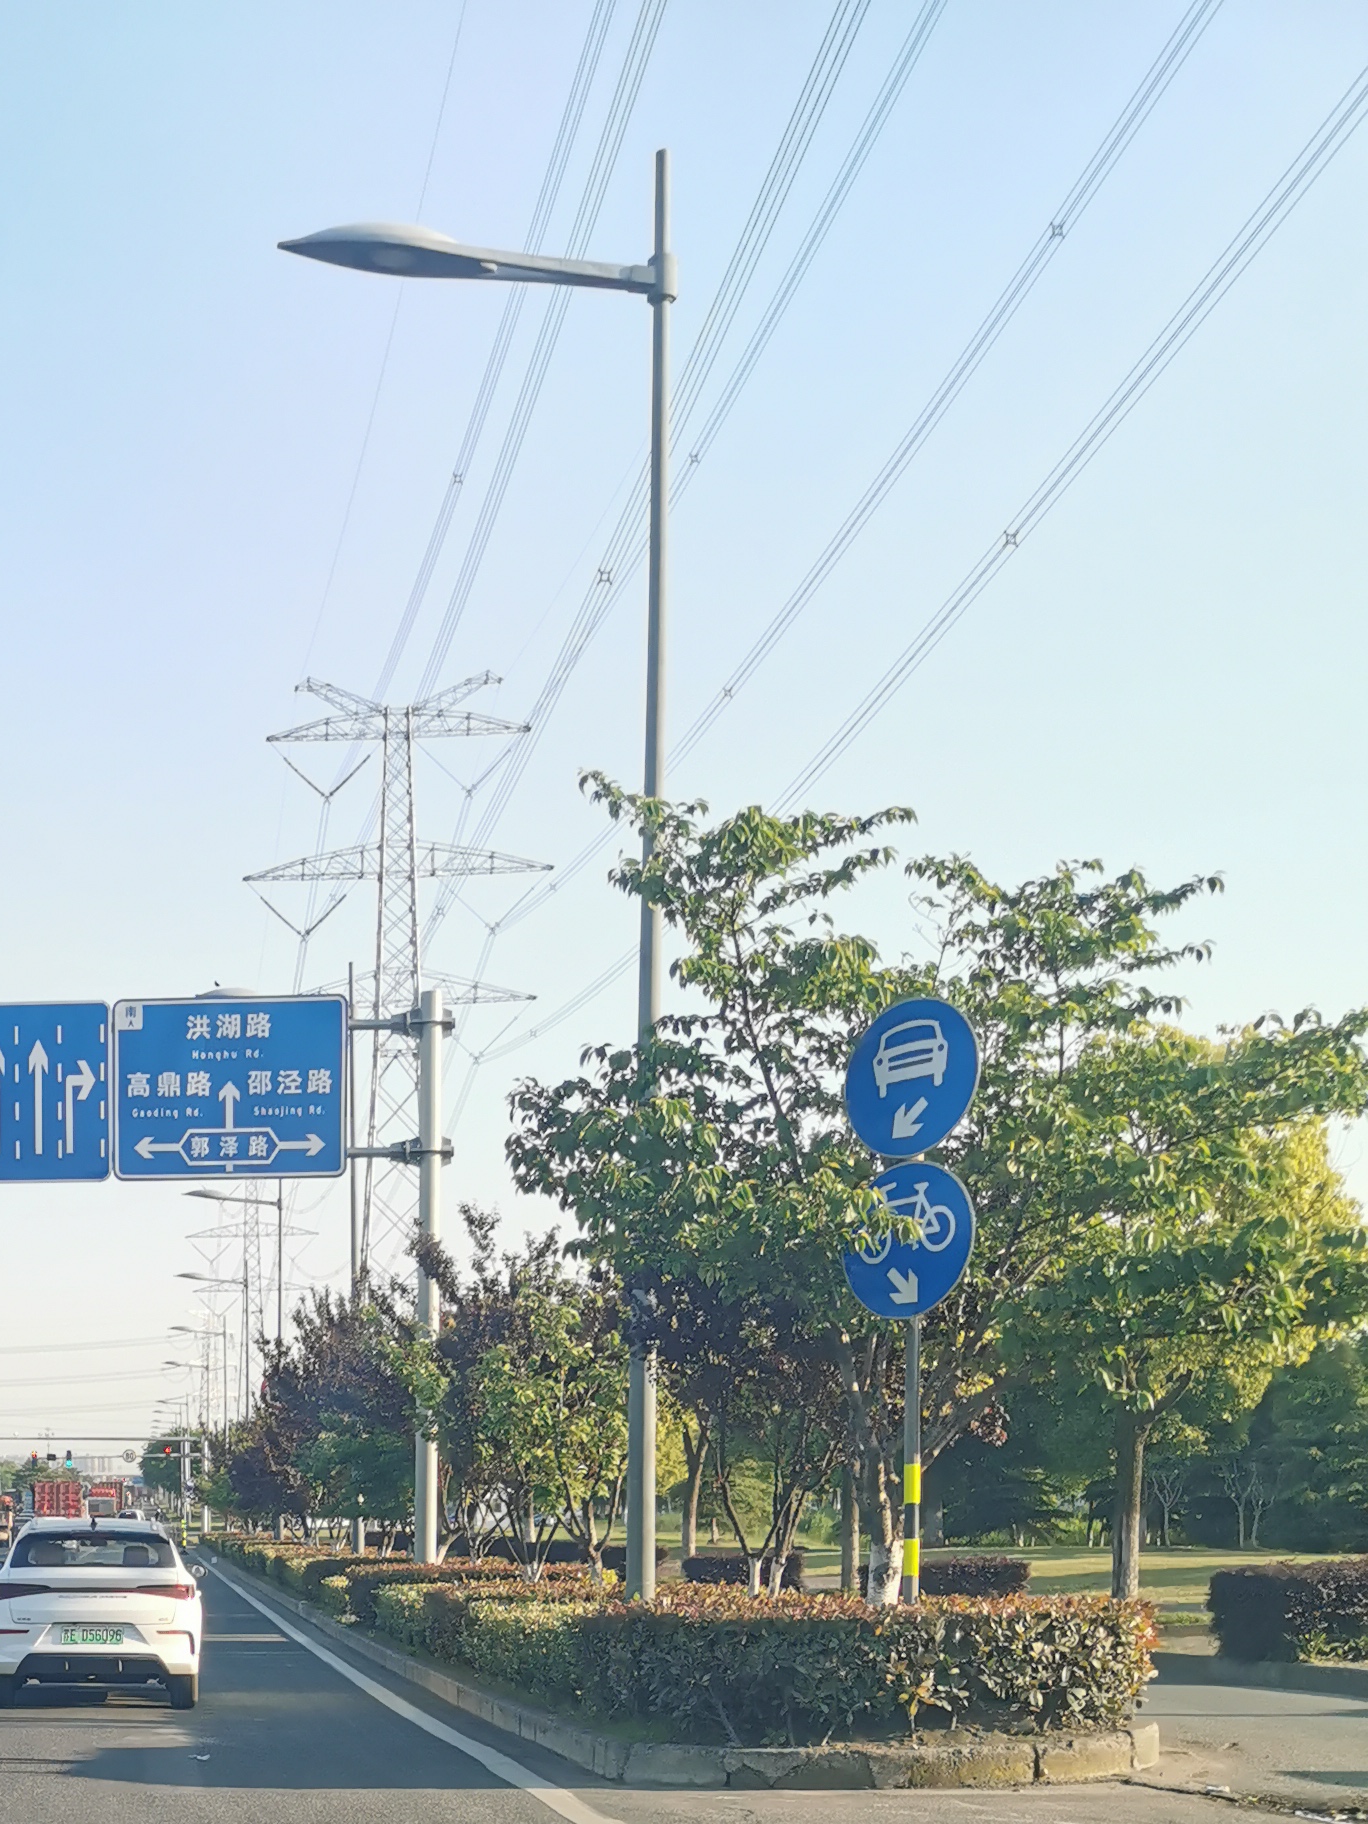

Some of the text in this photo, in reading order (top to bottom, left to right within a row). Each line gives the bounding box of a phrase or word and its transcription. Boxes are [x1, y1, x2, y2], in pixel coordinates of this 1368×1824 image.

[125, 1005, 137, 1018] 南
[185, 1012, 272, 1040] 洪湖路
[191, 1048, 264, 1061] Honghu Rd.
[126, 1070, 212, 1098] 高鼎路
[247, 1068, 333, 1096] 邵泾路
[132, 1108, 179, 1119] Gaoding
[190, 1135, 269, 1158] 郭泽路
